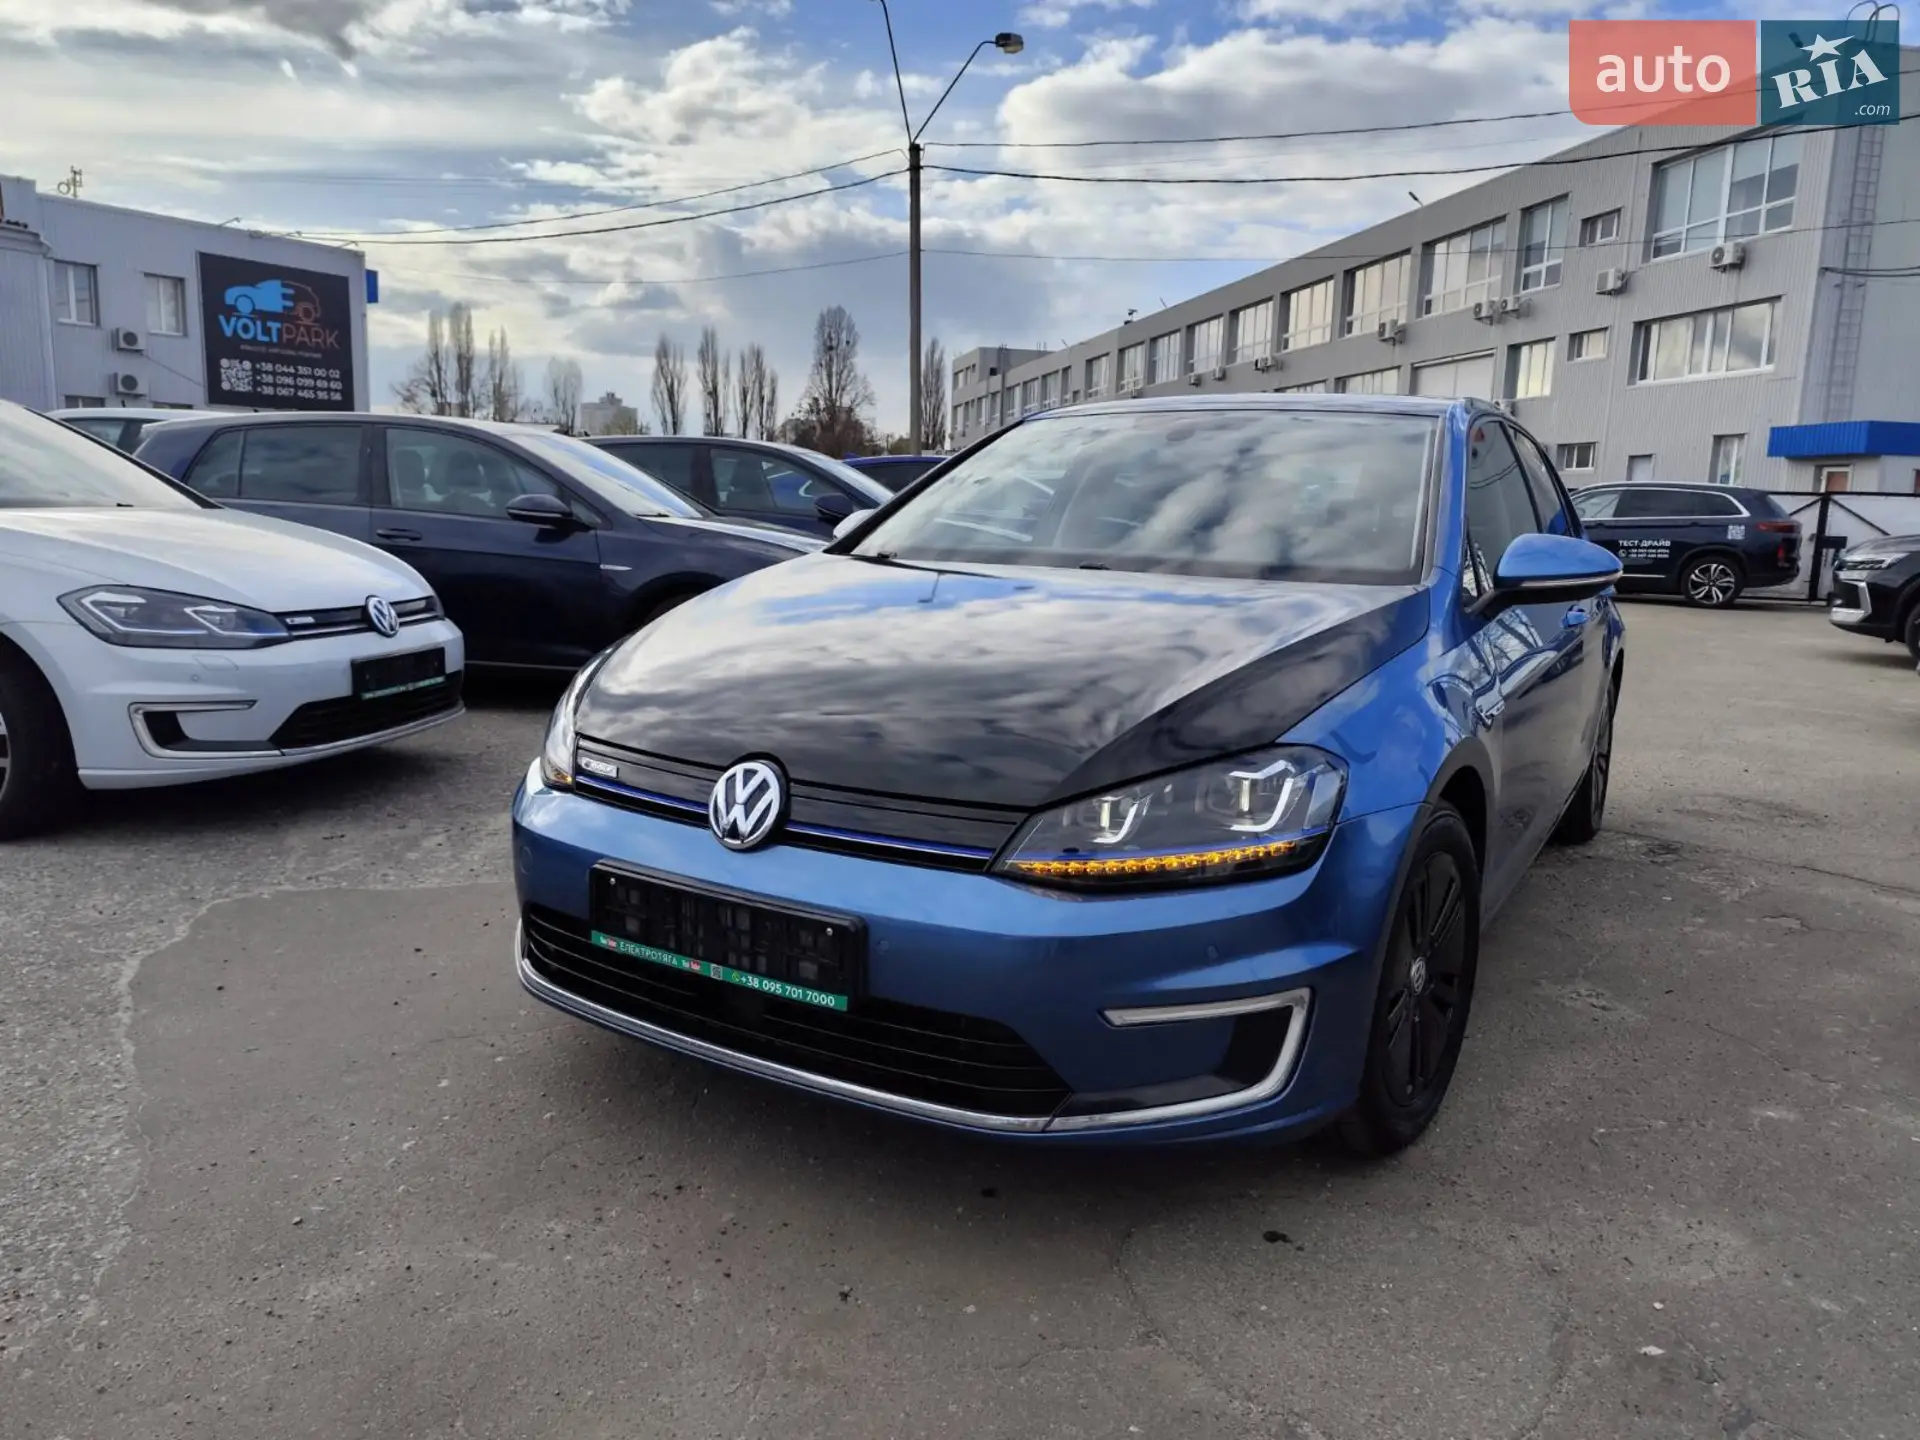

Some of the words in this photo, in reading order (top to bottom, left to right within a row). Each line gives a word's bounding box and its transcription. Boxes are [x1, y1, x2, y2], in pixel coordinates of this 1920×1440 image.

[620, 941, 678, 966] ЕЛЕКТРОТЯГА
[741, 976, 760, 989] +38
[762, 980, 782, 994] 095
[785, 985, 803, 1000] 701
[806, 990, 835, 1007] 7000
